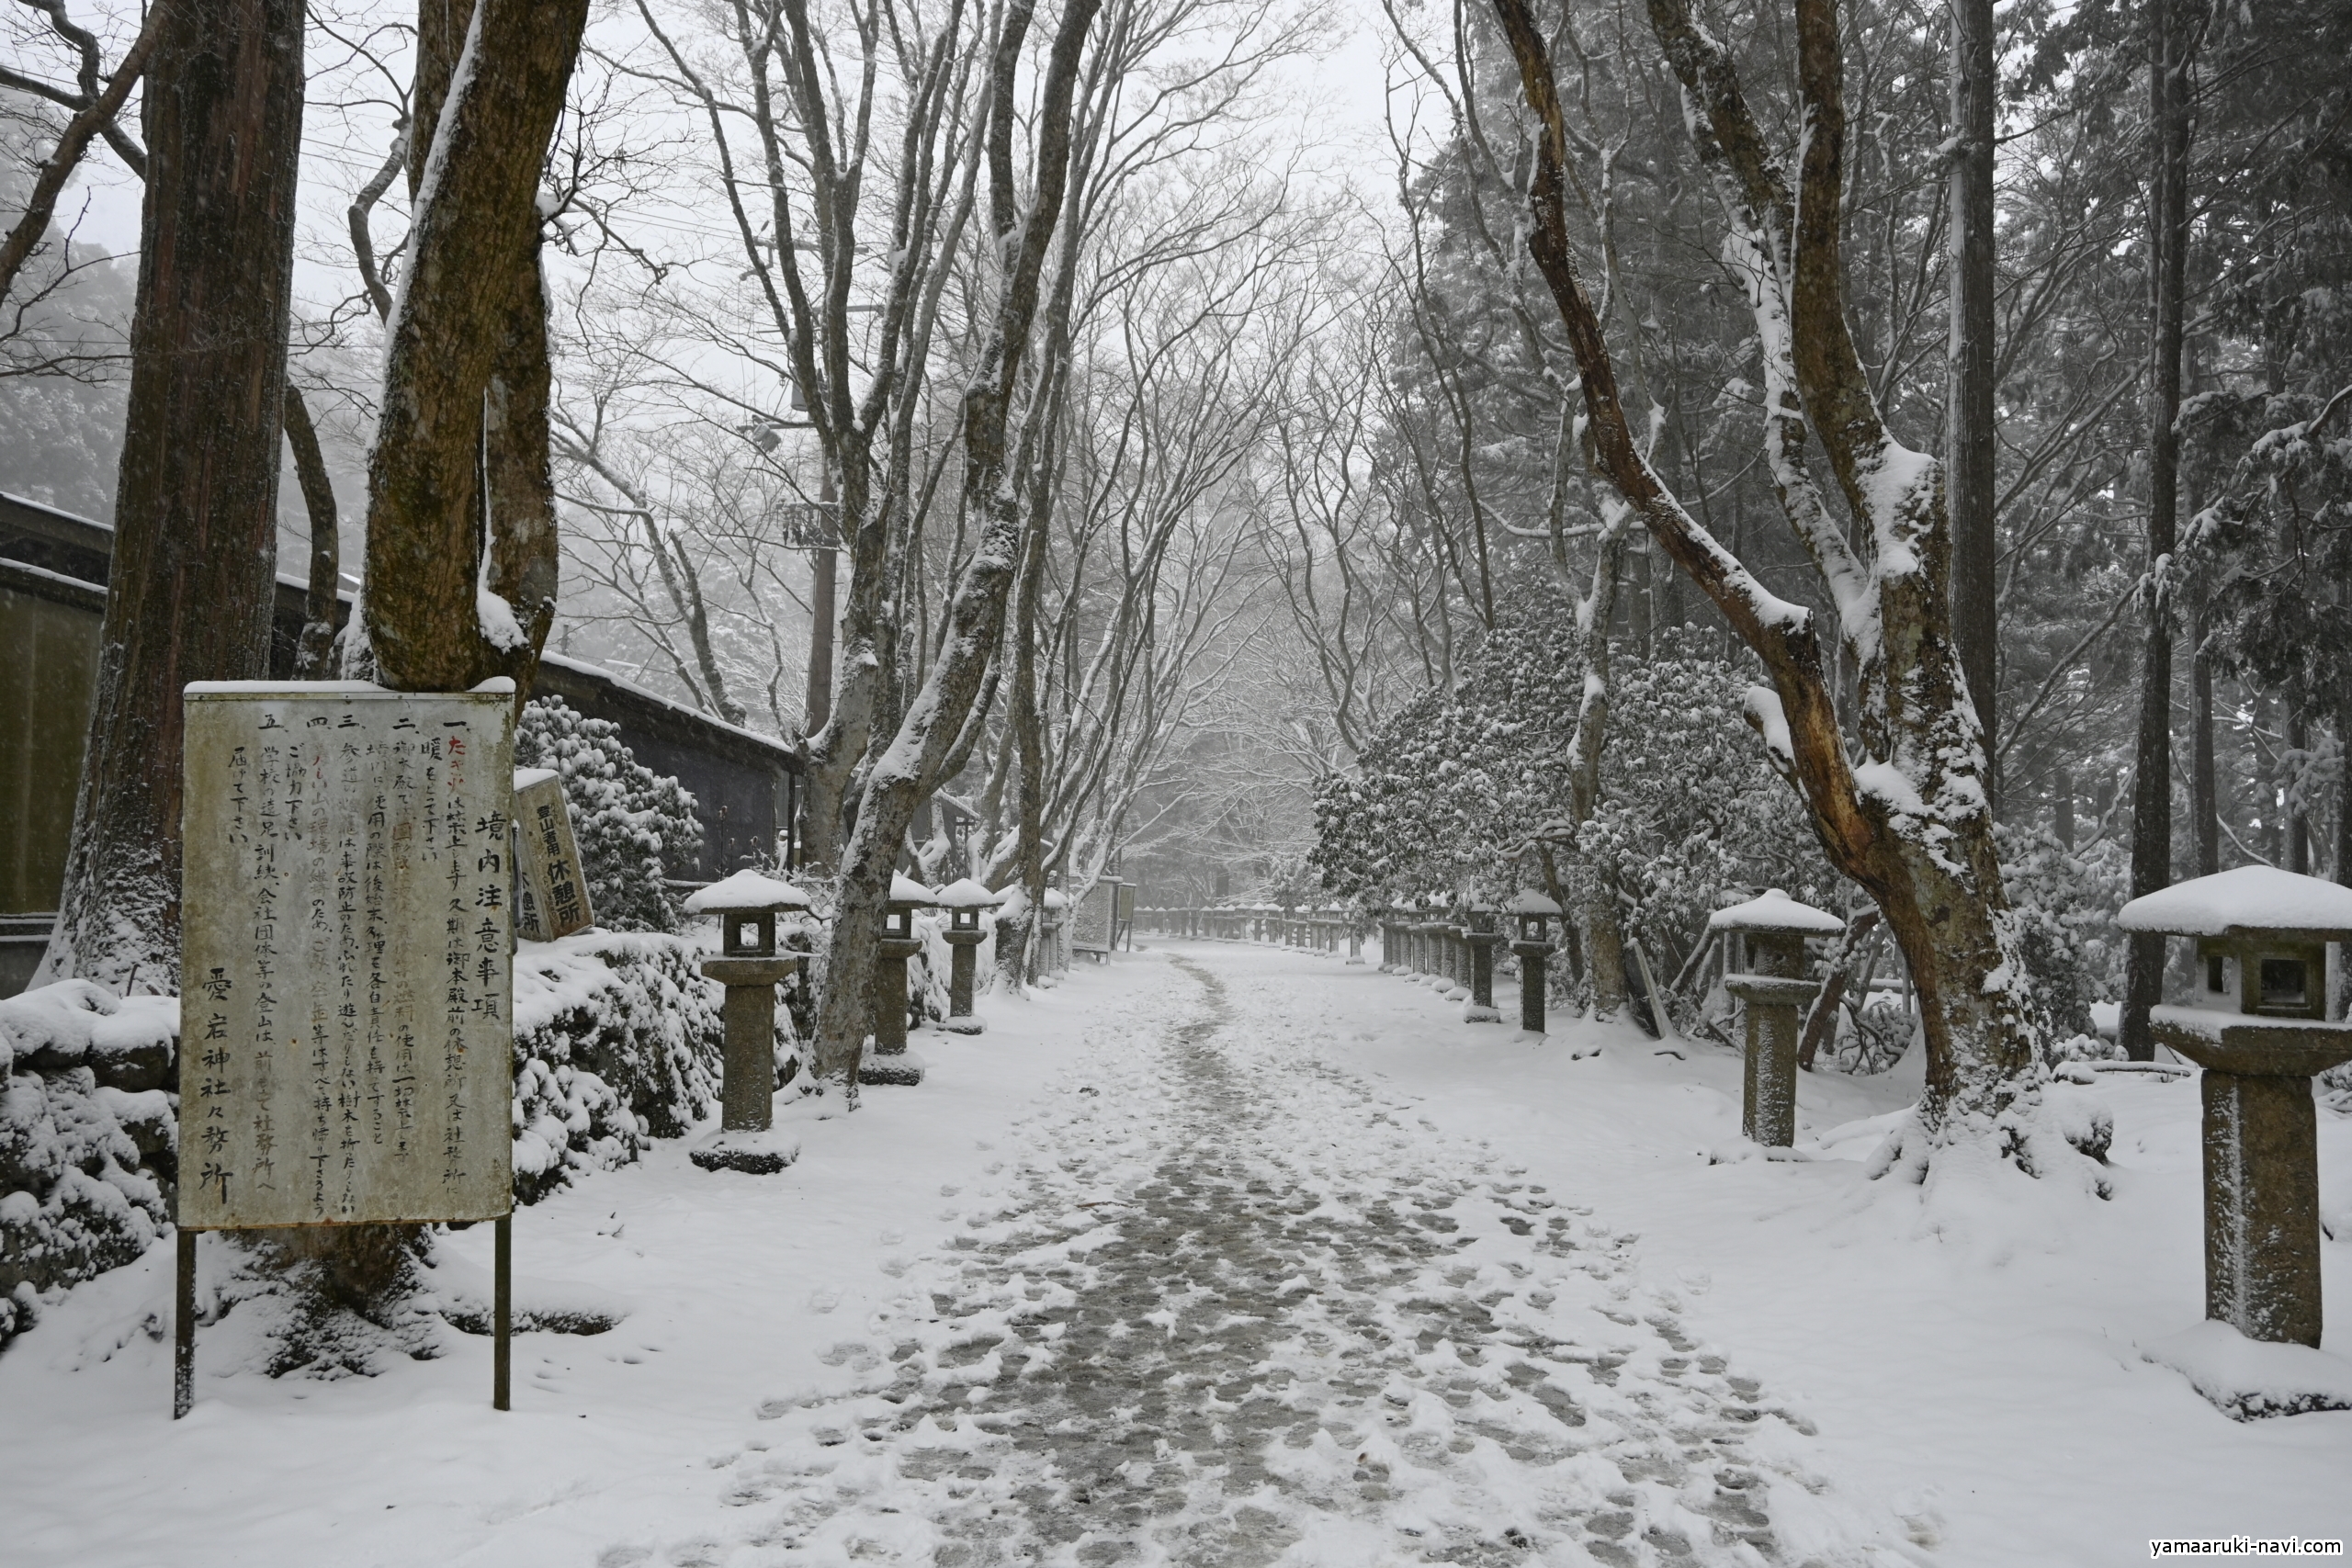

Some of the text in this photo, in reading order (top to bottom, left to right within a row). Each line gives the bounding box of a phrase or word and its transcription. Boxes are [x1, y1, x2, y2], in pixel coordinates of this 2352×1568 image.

[537, 805, 560, 858] 登山者用
[471, 811, 505, 1021] 境内注意事項
[547, 859, 581, 929] 休憩所
